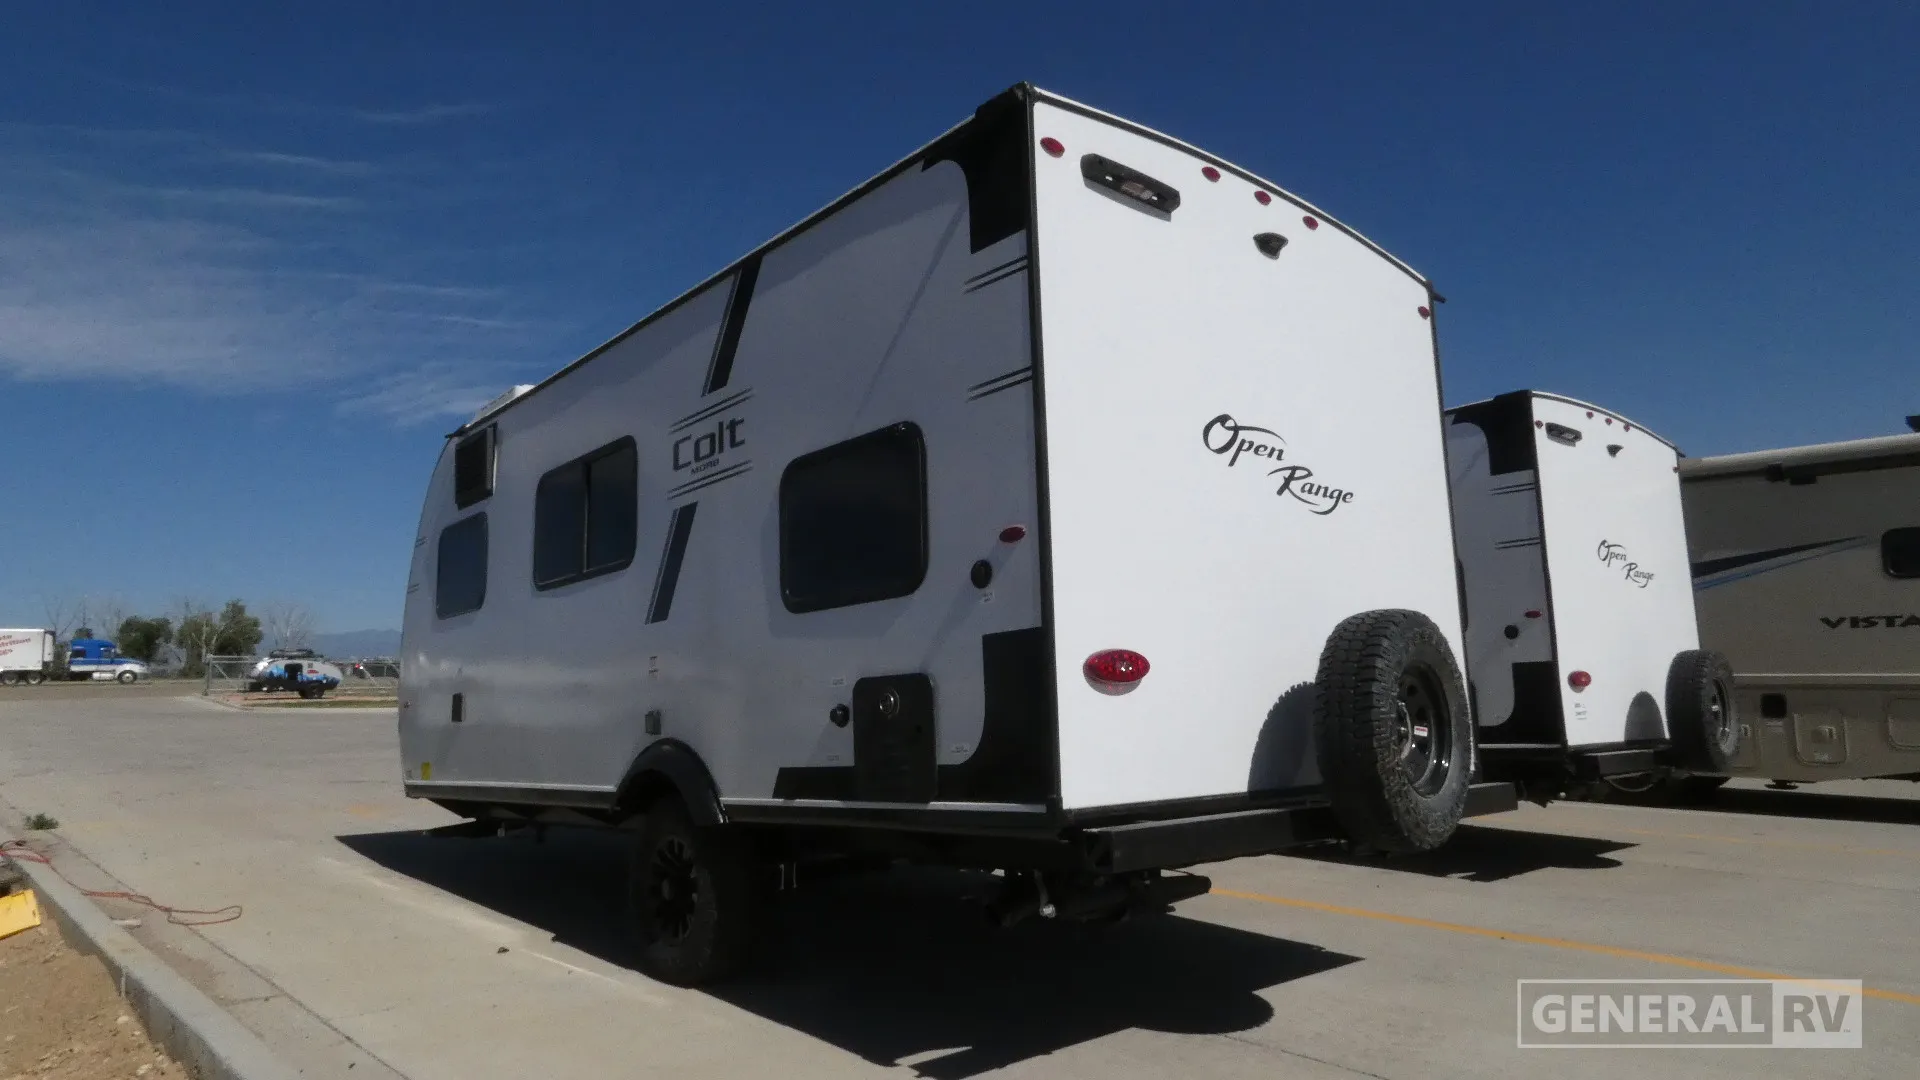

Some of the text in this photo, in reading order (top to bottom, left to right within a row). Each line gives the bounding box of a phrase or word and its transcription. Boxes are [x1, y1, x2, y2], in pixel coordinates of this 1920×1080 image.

[673, 418, 746, 472] Colt
[1203, 413, 1287, 468] Open
[1266, 465, 1354, 516] Range
[1597, 539, 1627, 568] Open
[1621, 562, 1655, 589] Range
[1819, 614, 1920, 629] VISTA
